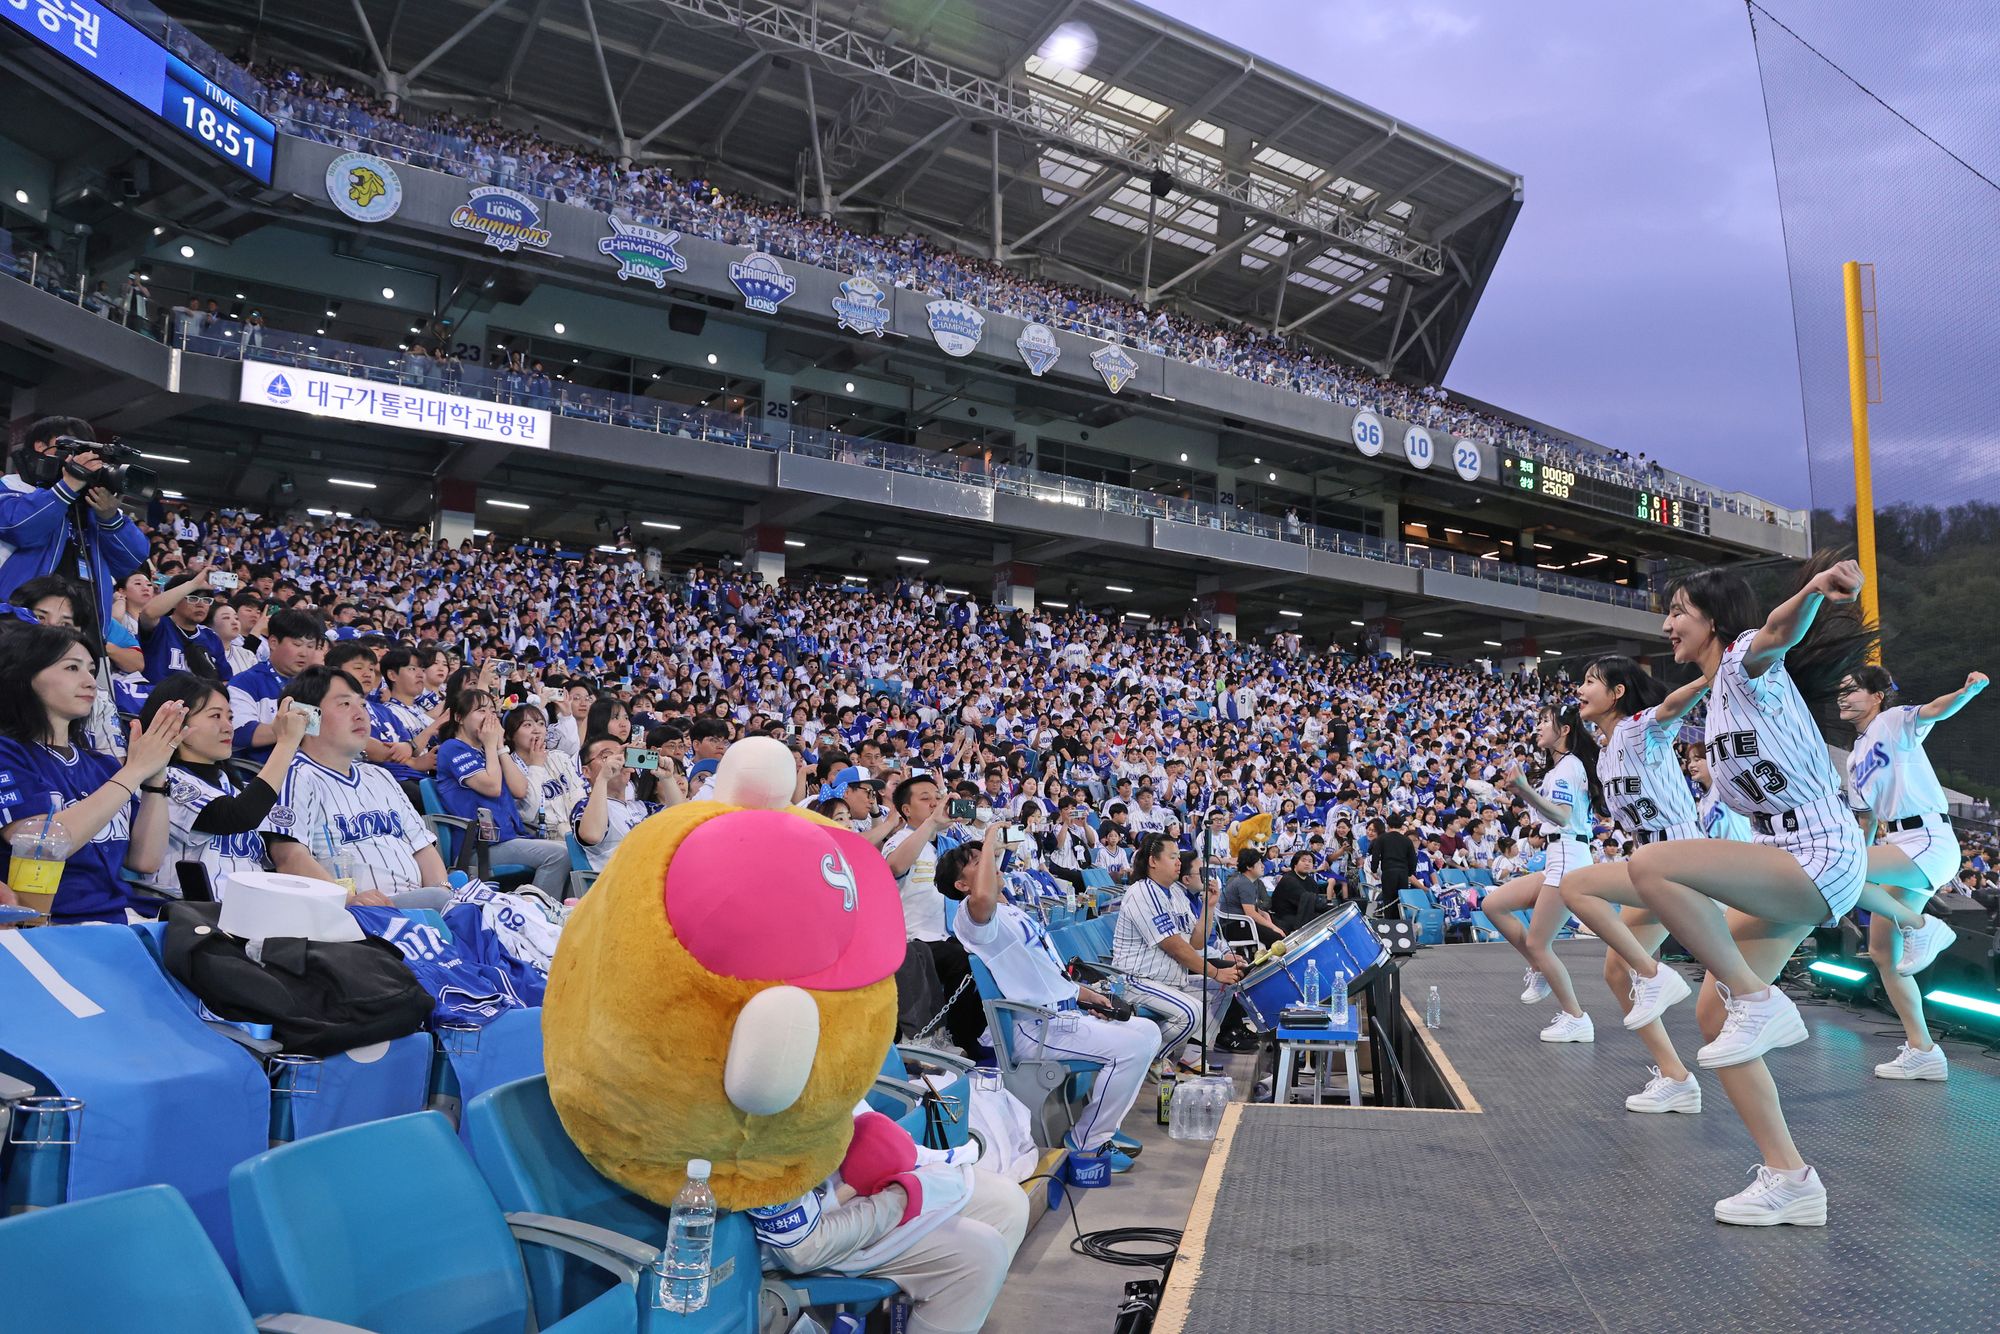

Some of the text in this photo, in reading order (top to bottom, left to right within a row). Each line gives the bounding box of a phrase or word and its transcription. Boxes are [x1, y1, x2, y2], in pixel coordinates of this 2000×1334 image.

[204, 80, 239, 116] TIME
[182, 96, 255, 168] 18:51
[472, 187, 504, 197] KOREAN
[486, 201, 522, 222] LIONS
[453, 206, 550, 245] Champions
[630, 226, 659, 240] 2005
[488, 235, 519, 250] 2002
[601, 239, 684, 269] CHAMPIONS
[625, 260, 661, 280] LIONS
[731, 264, 794, 293] CHAMPIONS
[748, 296, 776, 312] LIONS
[834, 299, 887, 321] CHAMPIONS
[854, 319, 868, 328] 2011
[930, 318, 980, 340] CHAMPIONS
[1031, 336, 1047, 344] 2013
[456, 343, 480, 361] 23
[1030, 350, 1047, 375] 7
[1094, 360, 1136, 376] CHAMPIONS
[1110, 373, 1119, 390] 8
[307, 379, 536, 439] 대구가톨릭대학교병원
[768, 402, 788, 419] 25
[1357, 421, 1380, 446] 36
[1410, 435, 1429, 458] 10
[1457, 448, 1478, 472] 22
[1220, 491, 1234, 505] 29
[1641, 493, 1648, 505] 3
[1653, 496, 1660, 509] 6
[1662, 498, 1667, 511] 1
[1672, 501, 1679, 514] 3
[1637, 505, 1648, 519] 10
[1650, 508, 1660, 522] 11
[1662, 511, 1667, 524] 1
[1672, 515, 1680, 527] 3
[180, 529, 193, 538] 30
[959, 610, 965, 618] 5
[1240, 694, 1246, 705] 5
[1706, 730, 1759, 768] TTE
[0, 774, 10, 783] 교
[1604, 776, 1642, 799] TTE
[1731, 759, 1788, 805] V3
[1621, 797, 1659, 828] V3
[333, 807, 404, 845] LIONS
[1140, 821, 1163, 831] LIONS
